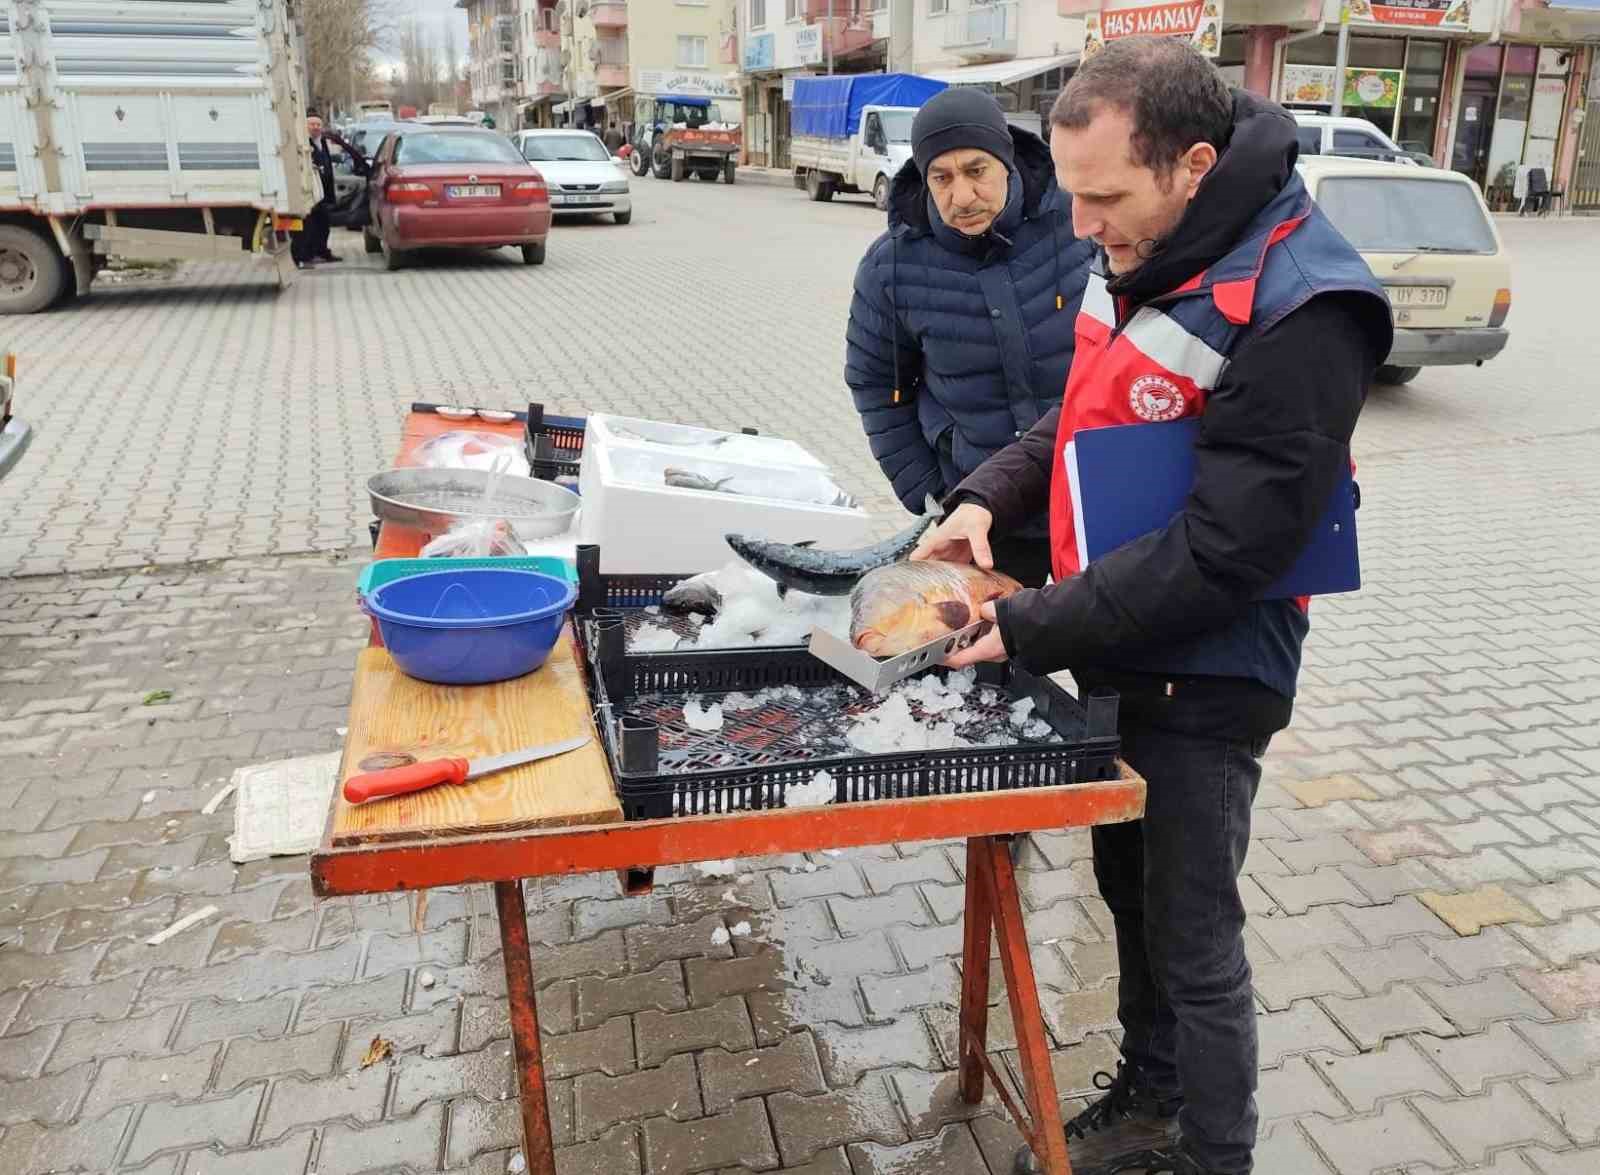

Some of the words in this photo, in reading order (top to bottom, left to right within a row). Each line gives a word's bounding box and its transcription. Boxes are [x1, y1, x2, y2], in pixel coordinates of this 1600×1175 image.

[1105, 13, 1135, 35] HAS
[1138, 5, 1201, 33] MANAV
[1398, 287, 1414, 303] UY
[1421, 288, 1444, 304] 370
